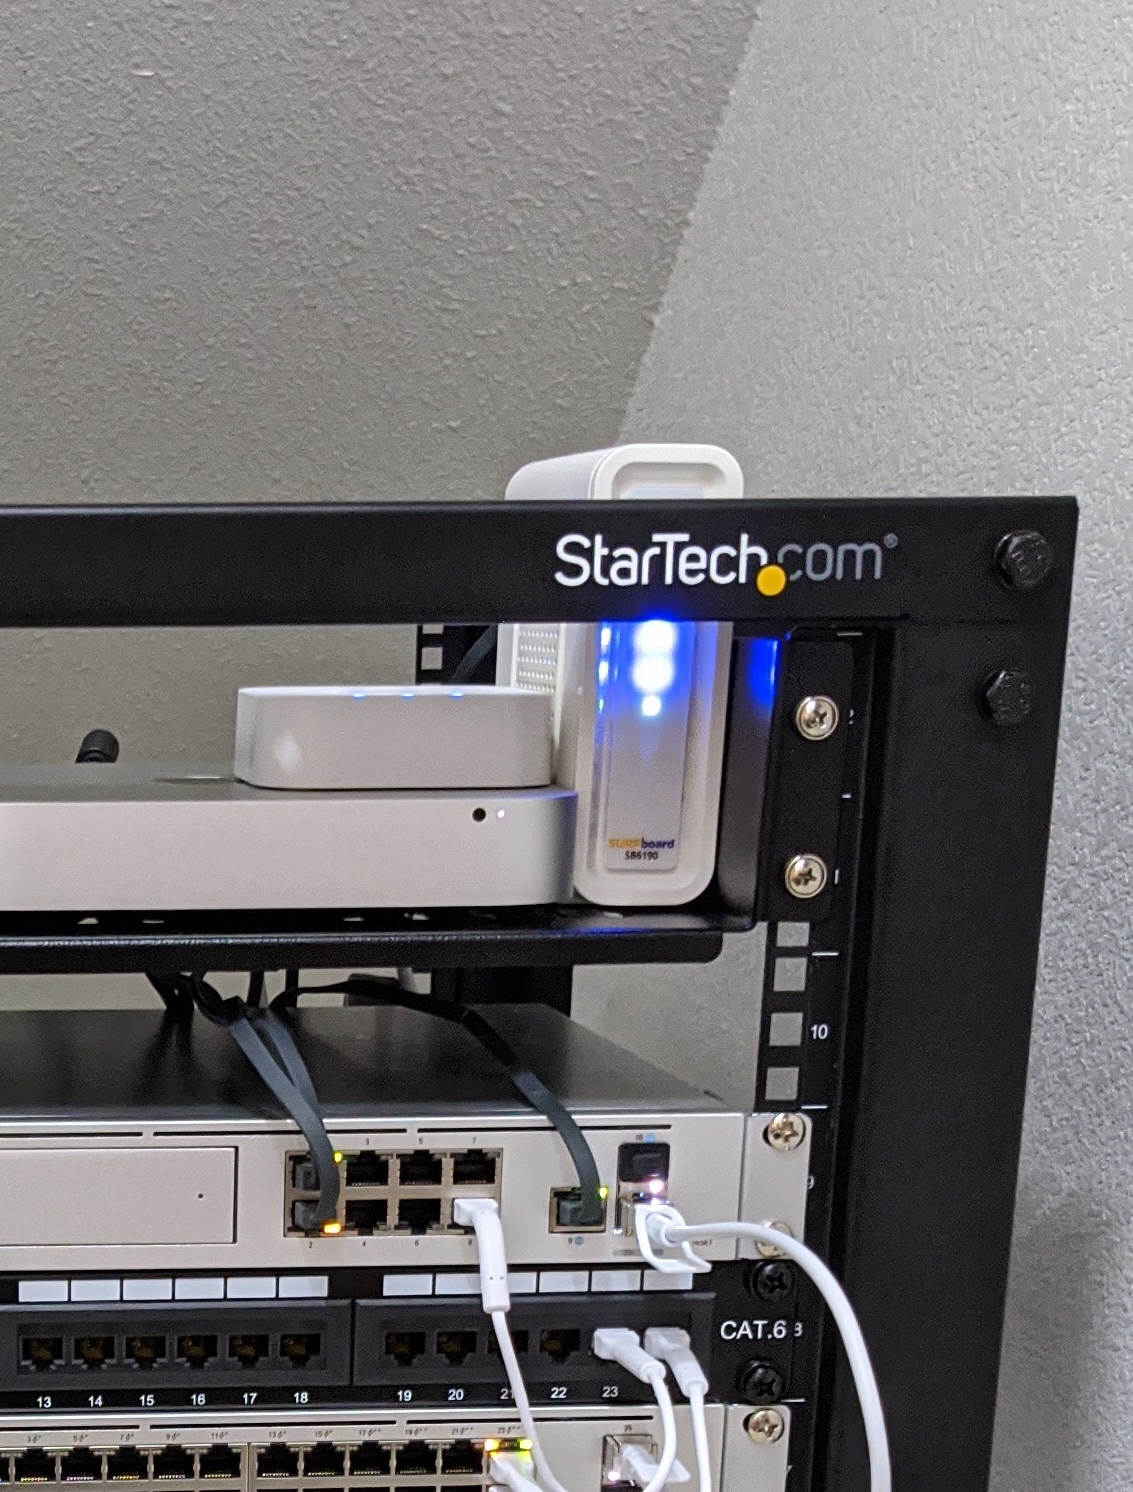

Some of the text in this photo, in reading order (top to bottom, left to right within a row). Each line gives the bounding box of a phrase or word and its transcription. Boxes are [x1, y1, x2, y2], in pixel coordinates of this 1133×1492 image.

[554, 533, 883, 597] StarTech.com
[810, 1023, 829, 1040] 10
[720, 1320, 787, 1340] CAT.6
[293, 1391, 309, 1404] 18
[397, 1389, 412, 1402] 19
[447, 1388, 464, 1401] 20
[550, 1386, 567, 1399] 22
[601, 1385, 619, 1398] 23
[36, 1396, 52, 1408] 13
[88, 1395, 103, 1407] 14
[139, 1394, 155, 1406] 15
[190, 1393, 206, 1405] 16
[242, 1392, 258, 1405] 17
